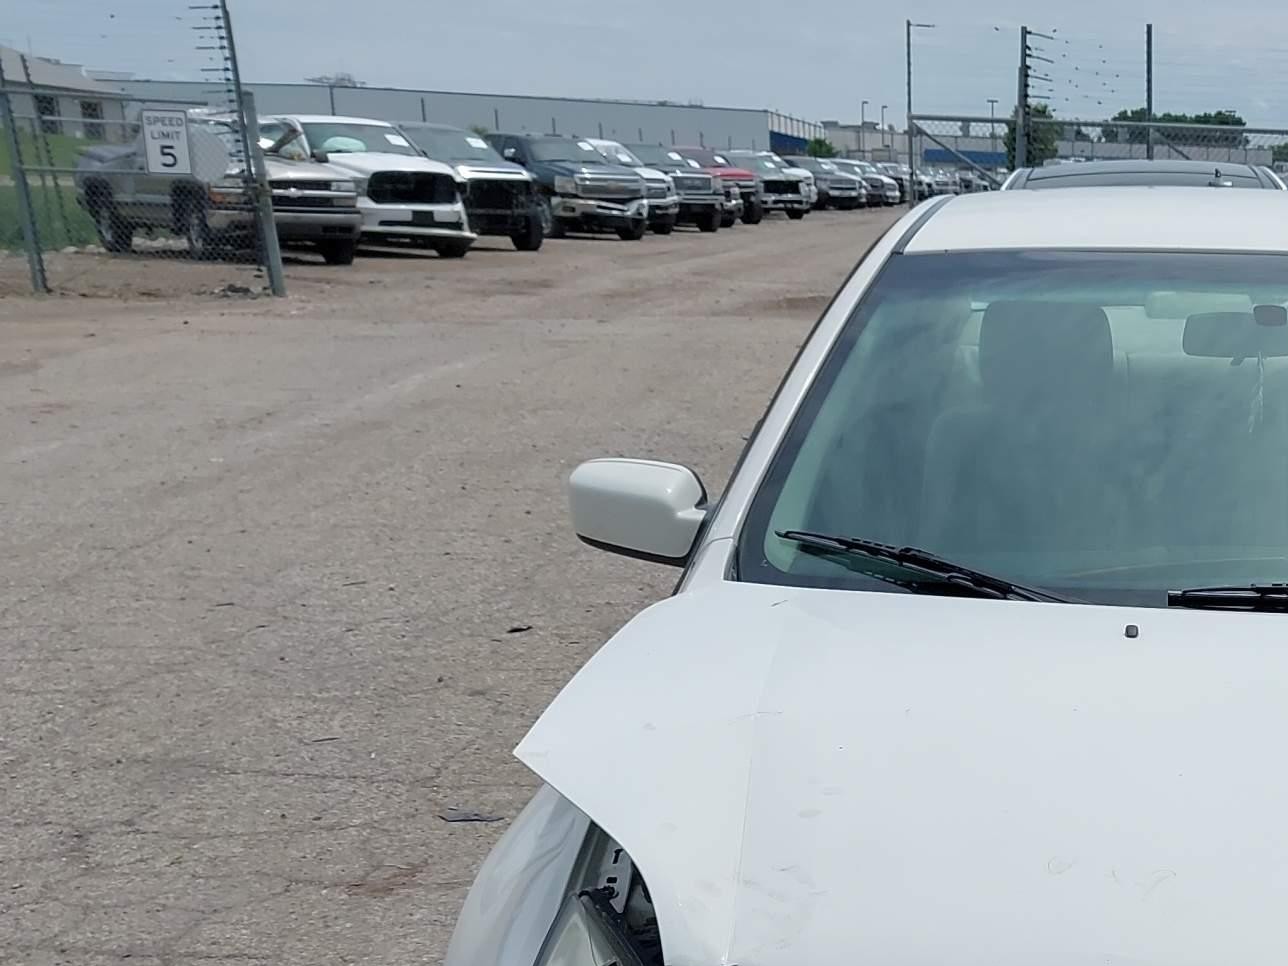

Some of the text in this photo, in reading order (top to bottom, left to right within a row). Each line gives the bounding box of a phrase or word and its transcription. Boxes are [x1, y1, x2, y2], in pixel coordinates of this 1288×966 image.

[145, 116, 184, 127] SPEED
[150, 130, 181, 140] LIMIT
[159, 145, 178, 168] 5
